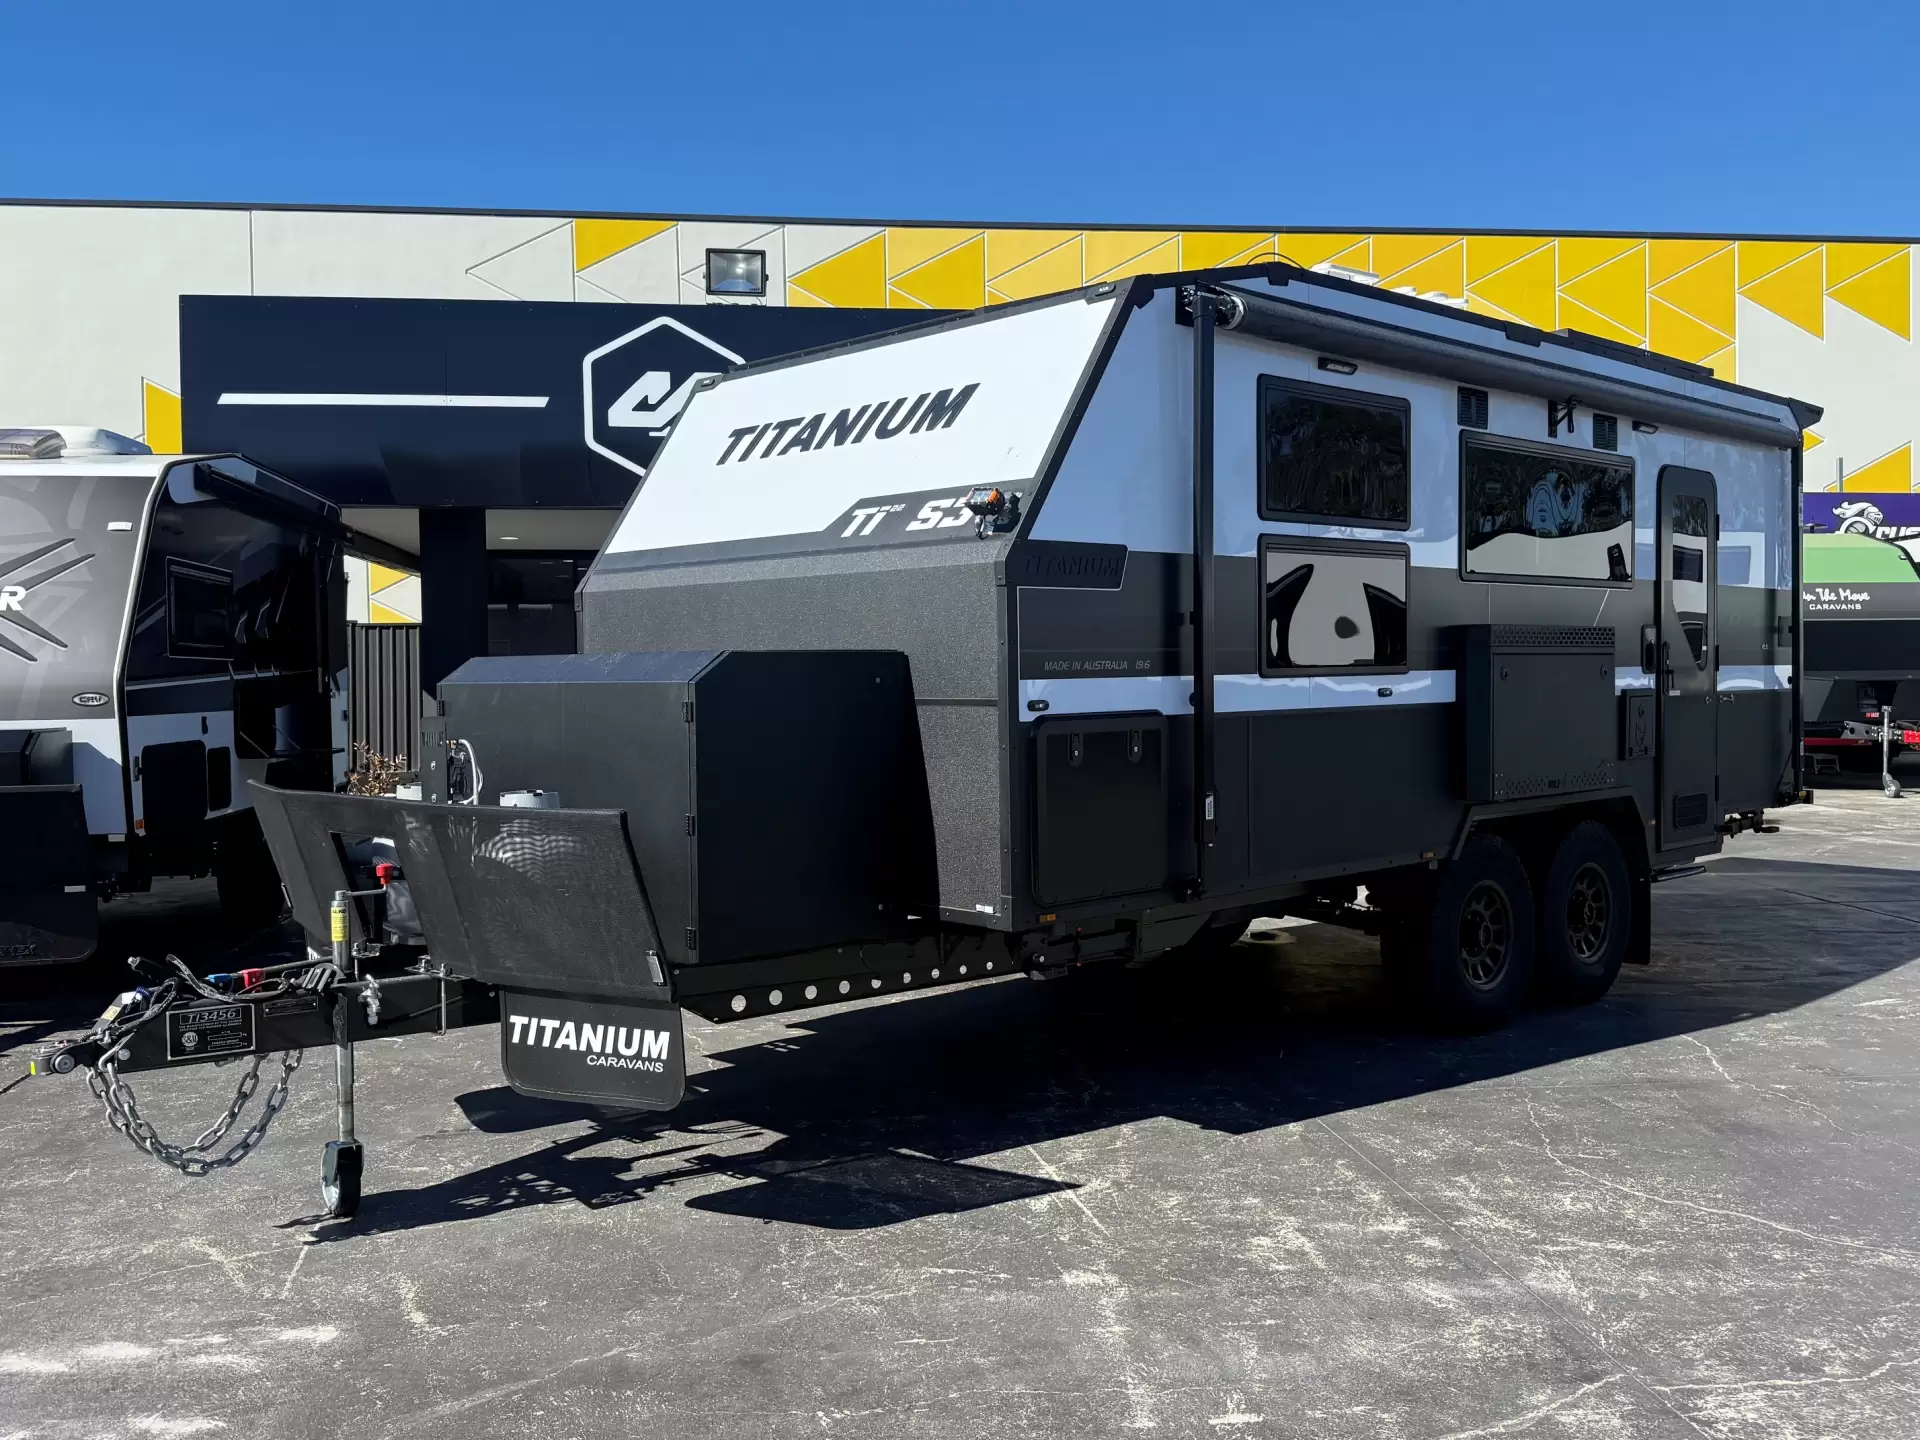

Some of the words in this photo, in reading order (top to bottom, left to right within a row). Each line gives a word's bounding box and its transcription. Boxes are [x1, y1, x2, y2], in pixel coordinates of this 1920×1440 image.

[715, 382, 981, 466] TITANIUM
[1044, 661, 1070, 671] MADE
[1072, 660, 1082, 671] IN
[1083, 660, 1128, 670] AUSTRALIA
[509, 1015, 671, 1060] TITANIUM
[586, 1054, 665, 1073] CARAVANS
